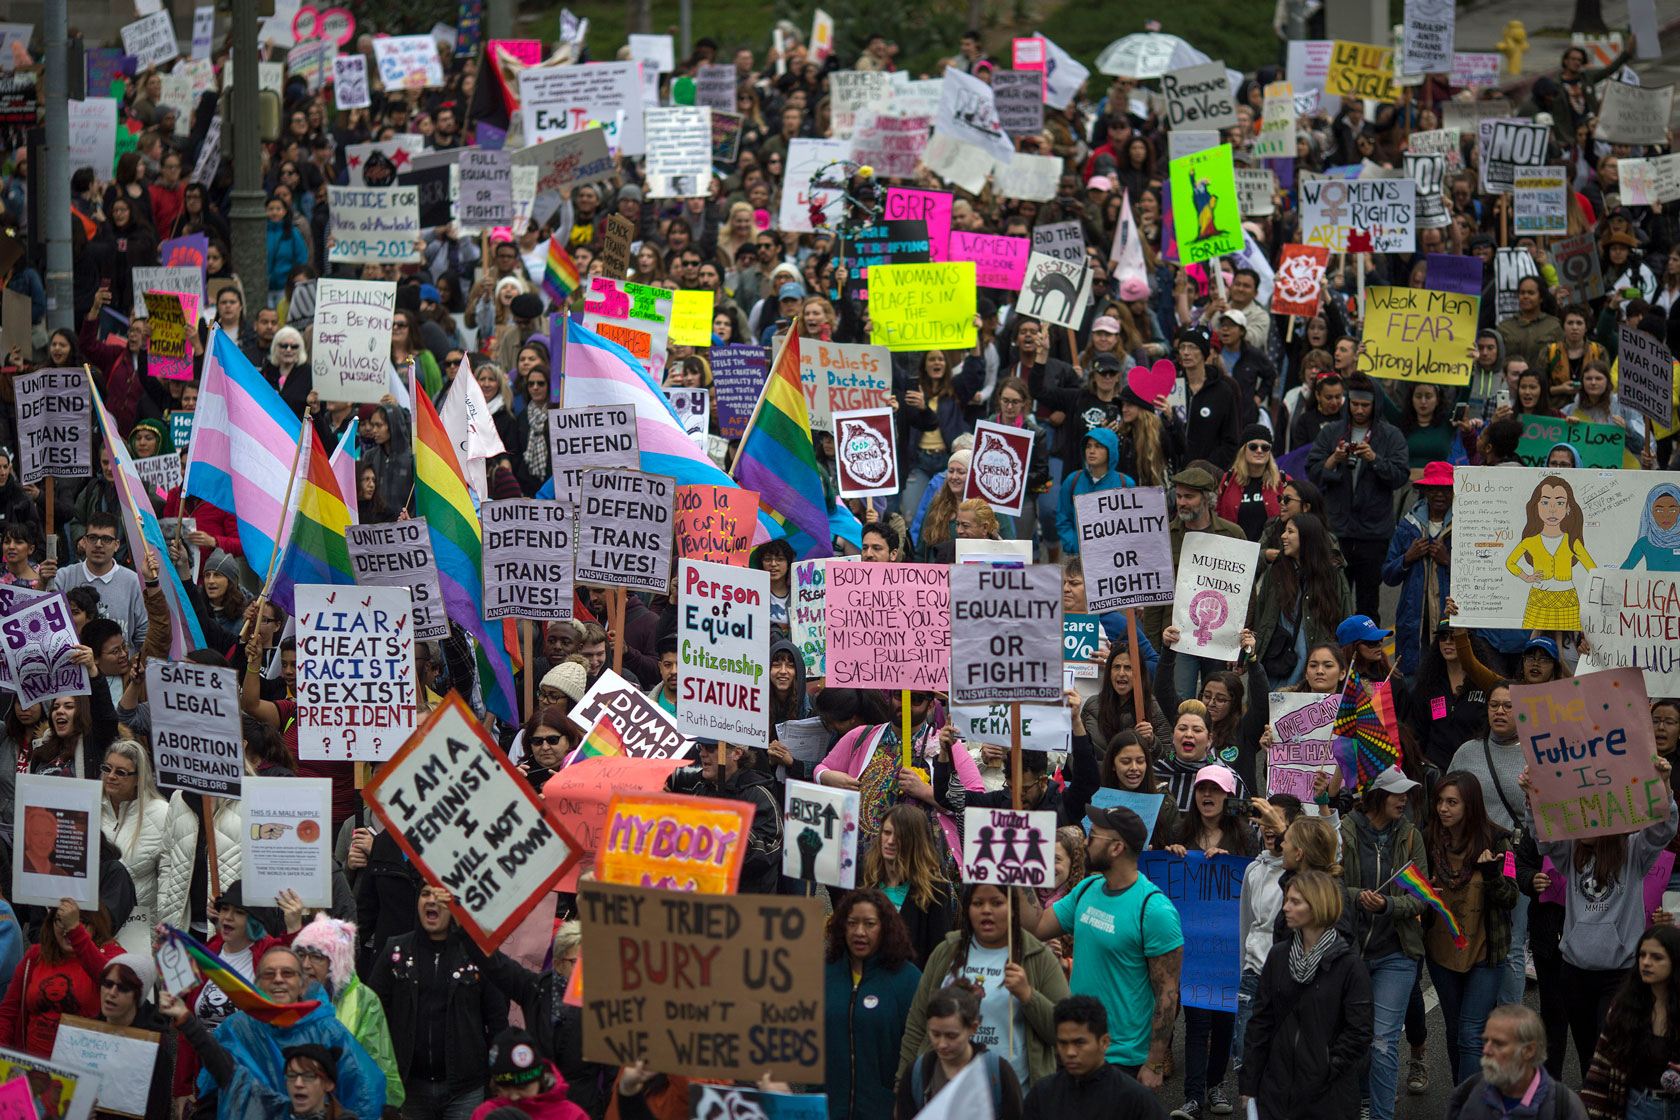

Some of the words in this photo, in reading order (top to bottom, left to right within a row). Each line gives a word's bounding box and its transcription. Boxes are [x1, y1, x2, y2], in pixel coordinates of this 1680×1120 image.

[1162, 74, 1228, 100] Remove
[1335, 66, 1401, 101] SIGUE
[1168, 95, 1233, 126] DeVos
[1491, 124, 1546, 165] NO!
[470, 153, 498, 166] FULL
[460, 169, 512, 181] EQUALITY
[331, 191, 388, 209] JUSTICE
[392, 192, 417, 207] FOR
[476, 190, 492, 202] OR
[890, 193, 935, 221] GRR
[466, 204, 505, 218] FIGHT!
[1352, 203, 1411, 229] RIGHTS
[961, 233, 1018, 257] WOMEN
[1035, 229, 1054, 245] END
[1059, 226, 1081, 240] THE
[1306, 224, 1352, 252] ARE
[1374, 238, 1402, 252] Rights
[1063, 247, 1081, 260] ON
[1190, 244, 1212, 261] FOR
[1212, 242, 1237, 256] ALL
[872, 268, 885, 287] A
[890, 265, 960, 286] WOMAN'S
[1036, 258, 1081, 277] RESIST!
[320, 284, 394, 308] FEMINISM
[591, 279, 616, 292] SHE
[624, 282, 644, 296] SHE
[651, 289, 673, 300] WAS
[872, 289, 917, 313] PLACE
[919, 290, 935, 306] IS
[938, 289, 956, 304] IN
[1369, 287, 1418, 310] Weak
[1427, 291, 1473, 316] Men
[903, 307, 928, 321] THE
[870, 319, 970, 345] REVOLUTION
[1386, 313, 1455, 342] FEAR
[1621, 328, 1648, 350] END
[1649, 339, 1672, 363] THE
[818, 346, 879, 372] Beliefs
[1357, 340, 1413, 377] Strong
[1415, 348, 1470, 376] Women
[1622, 348, 1650, 372] WAR
[1652, 361, 1669, 379] ON
[22, 374, 58, 395] UNITE
[61, 374, 82, 388] TO
[826, 371, 886, 391] Dictate
[1621, 365, 1669, 400] WOMEN'S
[22, 397, 84, 419] DEFEND
[1623, 385, 1668, 417] RIGHTS!
[556, 412, 603, 430] UNITE
[606, 411, 628, 427] TO
[27, 426, 80, 448] TRANS
[174, 429, 189, 438] for
[556, 433, 633, 457] DEFEND
[592, 472, 643, 493] UNITE
[647, 480, 666, 496] TO
[1460, 473, 1481, 493] You
[1484, 480, 1496, 493] do
[1498, 484, 1515, 493] not
[490, 505, 538, 522] UNITE
[544, 506, 565, 522] TO
[586, 497, 667, 522] DEFEND
[1097, 492, 1144, 514] FULL
[1458, 498, 1480, 507] Come
[352, 526, 395, 546] UNITE
[400, 525, 420, 540] TO
[488, 529, 568, 549] DEFEND
[590, 526, 660, 551] TRANS
[1082, 515, 1166, 541] EQUALITY
[1495, 529, 1514, 542] YOU
[355, 549, 428, 572] DEFEND
[590, 549, 656, 574] LIVES!
[1112, 549, 1139, 569] OR
[1191, 553, 1246, 574] MUJERES
[494, 562, 562, 582] TRANS
[578, 568, 666, 587] ANSWERcoalition.ORG
[978, 571, 1034, 591] FULL
[1097, 571, 1161, 597] FIGHT!
[1195, 574, 1241, 594] UNIDAS
[497, 585, 559, 606] LIVES!
[685, 566, 760, 606] Person
[711, 602, 732, 618] of
[847, 589, 905, 609] GENDER
[954, 600, 1059, 620] EQUALITY
[1089, 591, 1174, 612] ANSWERcoalition.ORG
[314, 610, 401, 637] LIAR,
[486, 606, 571, 618] ANSWERcoalition.ORG
[685, 604, 753, 645] Equal
[304, 636, 407, 661] CHEATS,
[832, 630, 906, 650] MISOGYNY
[914, 631, 926, 646] &
[989, 635, 1024, 657] OR
[681, 639, 764, 685] Citizenship
[873, 647, 946, 665] BULLSHIT
[160, 666, 206, 687] SAFE
[209, 672, 223, 690] &
[304, 658, 404, 682] RACIST,
[967, 661, 1047, 685] FIGHT!
[163, 691, 226, 718] LEGAL
[307, 681, 411, 705] SEXIST,
[682, 676, 761, 713] STATURE
[956, 686, 1060, 700] ANSWERcoalition.ORG
[297, 704, 417, 728] PRESIDENT
[610, 692, 680, 748] DUMP
[1279, 712, 1308, 739] WE
[1307, 698, 1340, 727] CAN
[1520, 694, 1586, 728] The
[157, 731, 238, 759] ABORTION
[160, 753, 180, 769] ON
[183, 758, 240, 778] DEMAND
[177, 774, 228, 790] PSLWEB.ORG
[389, 788, 417, 821] I
[414, 754, 448, 801] AM
[446, 737, 470, 764] A
[250, 809, 264, 817] THIS
[561, 797, 584, 815] ONE
[1539, 776, 1665, 838] FEMALE
[454, 808, 480, 838] I
[989, 809, 1031, 830] United
[441, 846, 488, 890] WILL
[483, 800, 524, 850] NOT
[607, 812, 655, 853] MY
[650, 818, 738, 867] BODY
[465, 867, 502, 912] SIT
[496, 817, 553, 879] DOWN
[581, 890, 646, 928] THEY
[660, 899, 741, 940] TRIED
[757, 906, 807, 941] TO
[1583, 902, 1610, 913] MMHS
[618, 936, 722, 991] BURY
[741, 946, 795, 994] US
[966, 965, 985, 977] ONLY
[986, 966, 1002, 977] YOU
[588, 996, 648, 1030] THEY
[664, 1000, 736, 1023] DIDN'T
[760, 1001, 818, 1024] KNOW
[69, 1035, 122, 1053] WOMEN'S
[602, 1030, 649, 1063] WE
[666, 1028, 741, 1069] WERE
[748, 1024, 819, 1068] SEEDS
